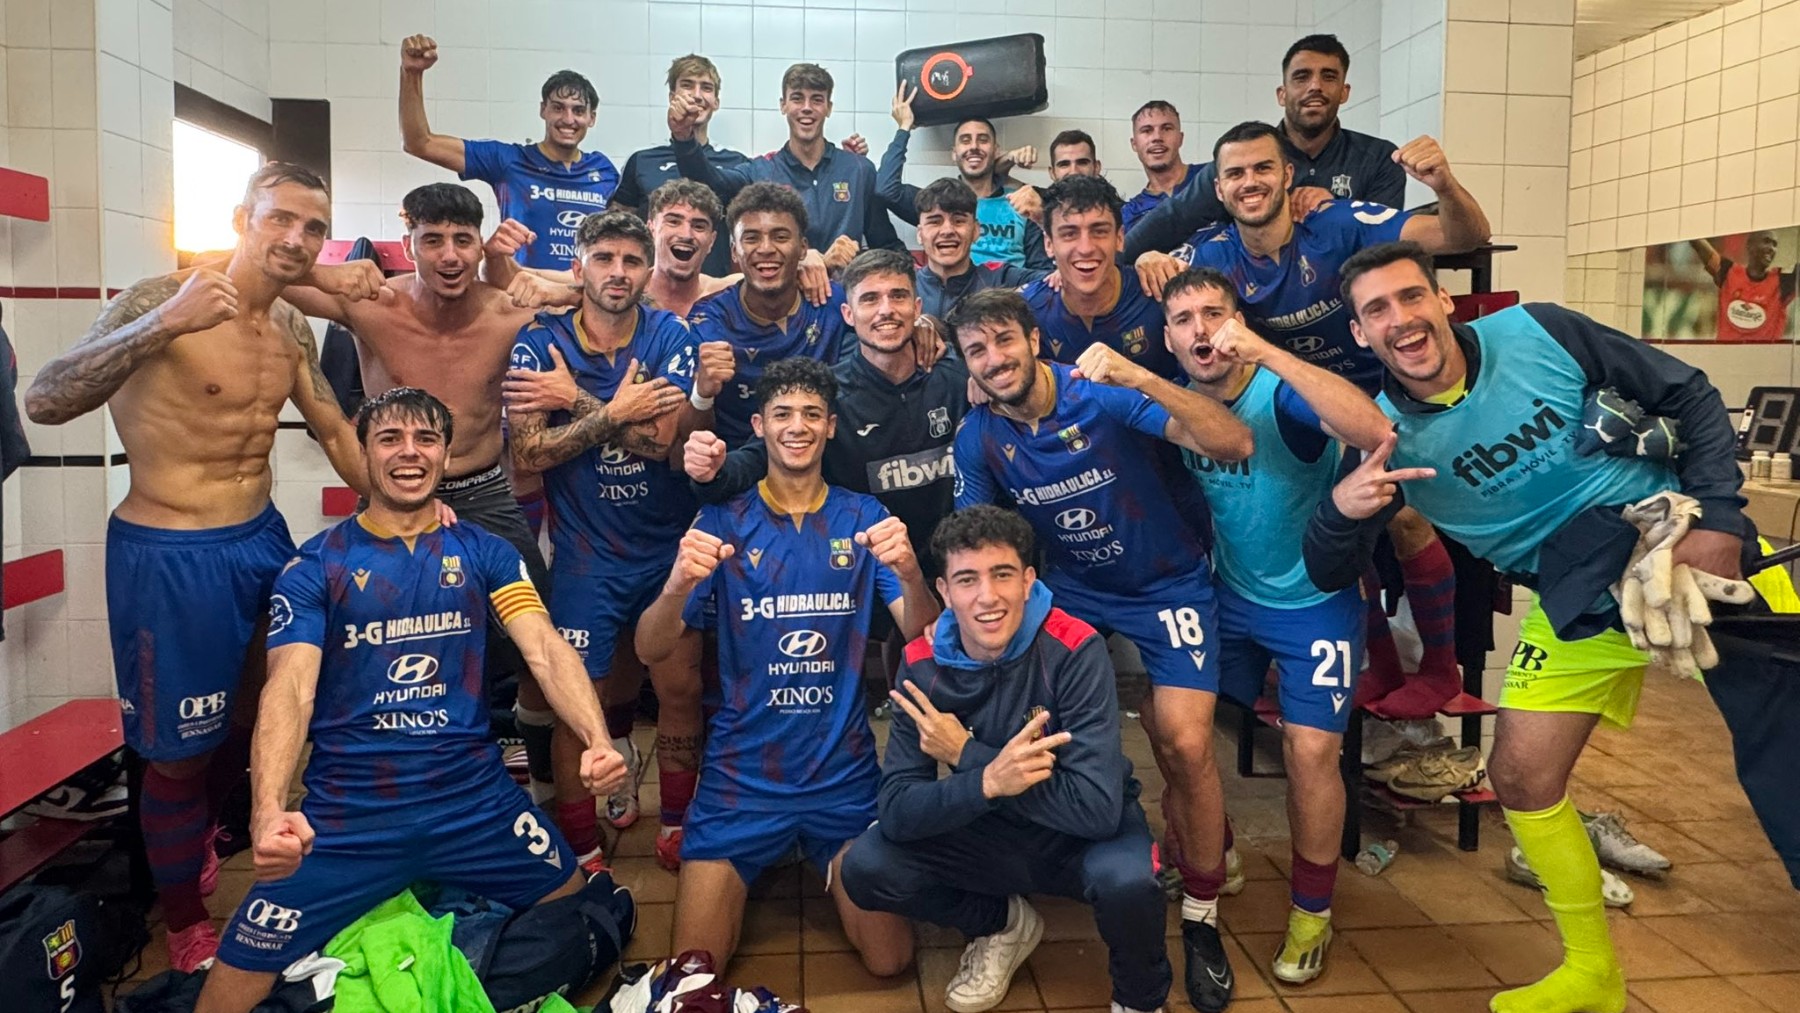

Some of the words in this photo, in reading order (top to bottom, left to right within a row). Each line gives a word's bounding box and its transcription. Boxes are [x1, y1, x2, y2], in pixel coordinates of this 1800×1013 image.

[530, 185, 555, 201] 3-G
[1452, 398, 1567, 488] fibwi
[877, 446, 956, 490] fibwi
[1034, 467, 1104, 501] HIDRAULICA
[1480, 476, 1516, 498] FIBRA
[741, 597, 775, 621] 3-G
[776, 592, 851, 614] HIDRAULICA
[343, 621, 383, 649] 3-G
[386, 610, 462, 639] HIDRAULICA
[1157, 606, 1204, 649] 18
[768, 660, 835, 676] HYUNDAI
[1311, 639, 1351, 689] 21
[1510, 640, 1548, 671] PB
[179, 691, 227, 720] OPB
[373, 683, 447, 705] HYUNDAI
[766, 685, 834, 707] XINO'S
[372, 708, 450, 730] XINO'S
[513, 811, 550, 855] 3
[246, 897, 303, 932] OPB
